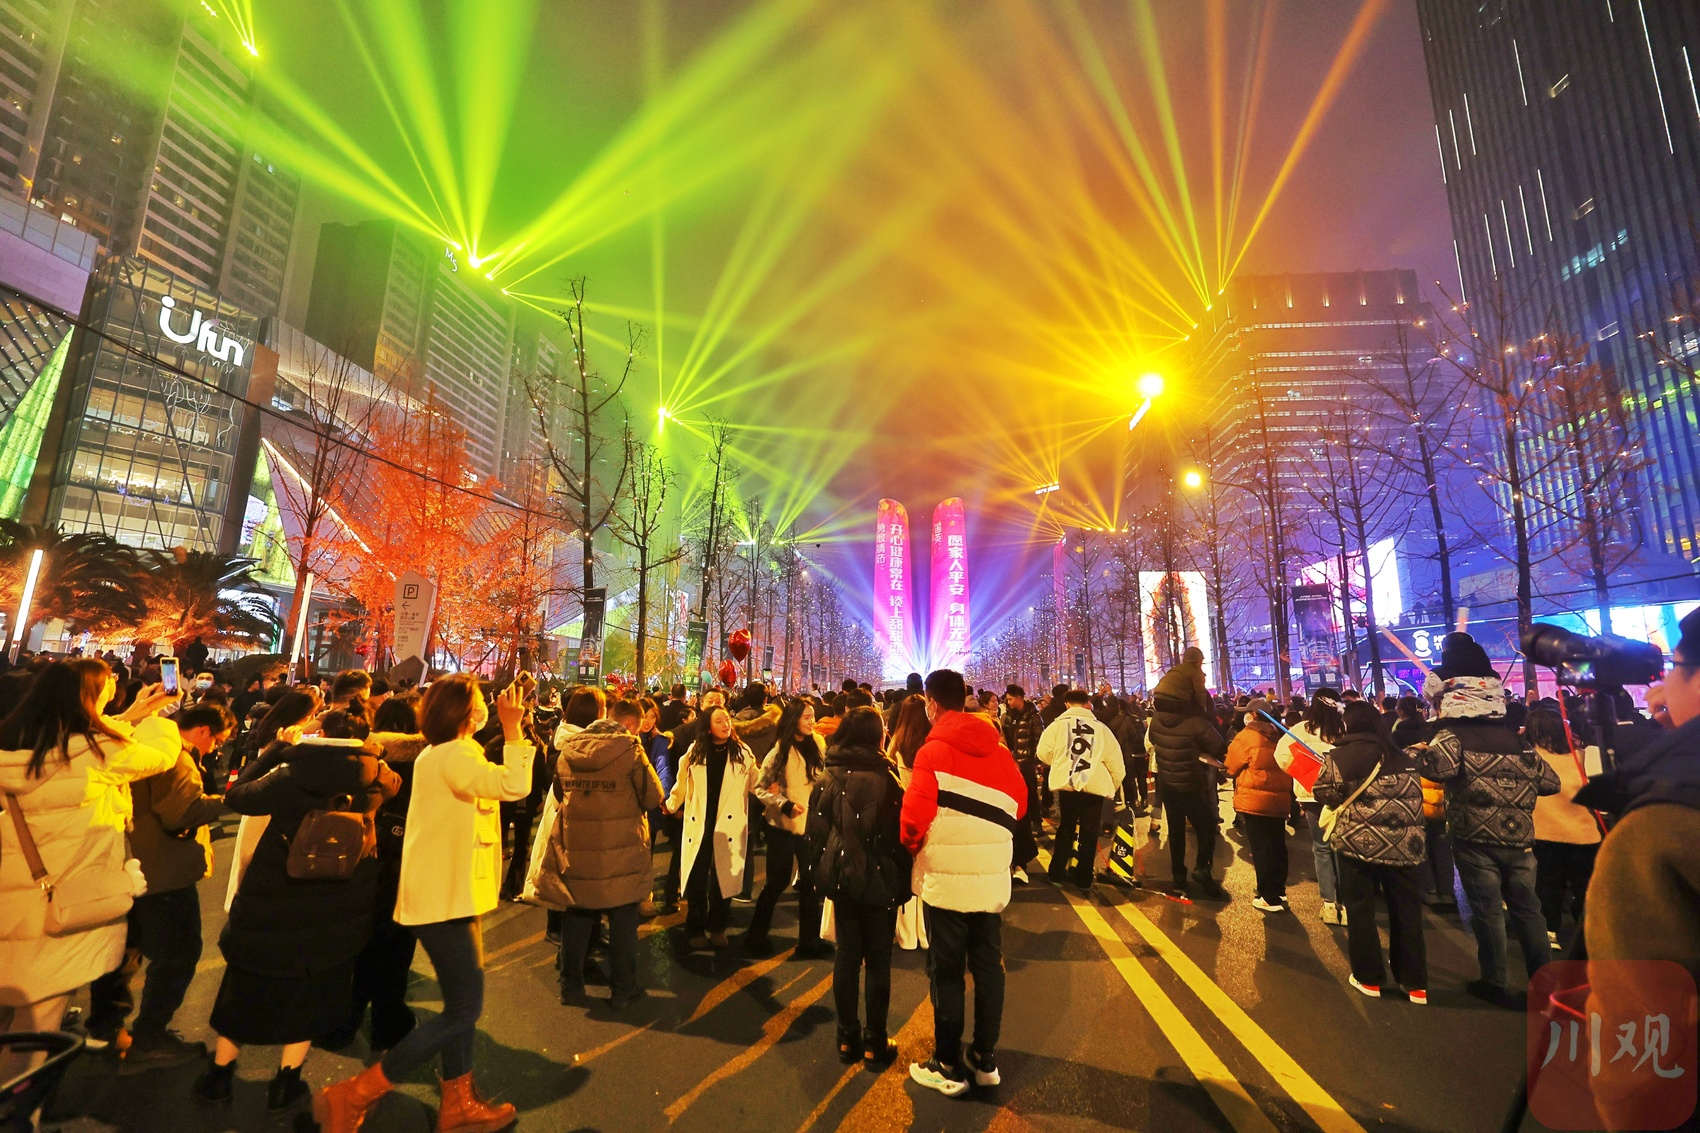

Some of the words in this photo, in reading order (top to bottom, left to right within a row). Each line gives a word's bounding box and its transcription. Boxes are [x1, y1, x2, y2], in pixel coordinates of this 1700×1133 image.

[947, 534, 964, 596] 愿家人平安
[602, 781, 616, 790] SUN
